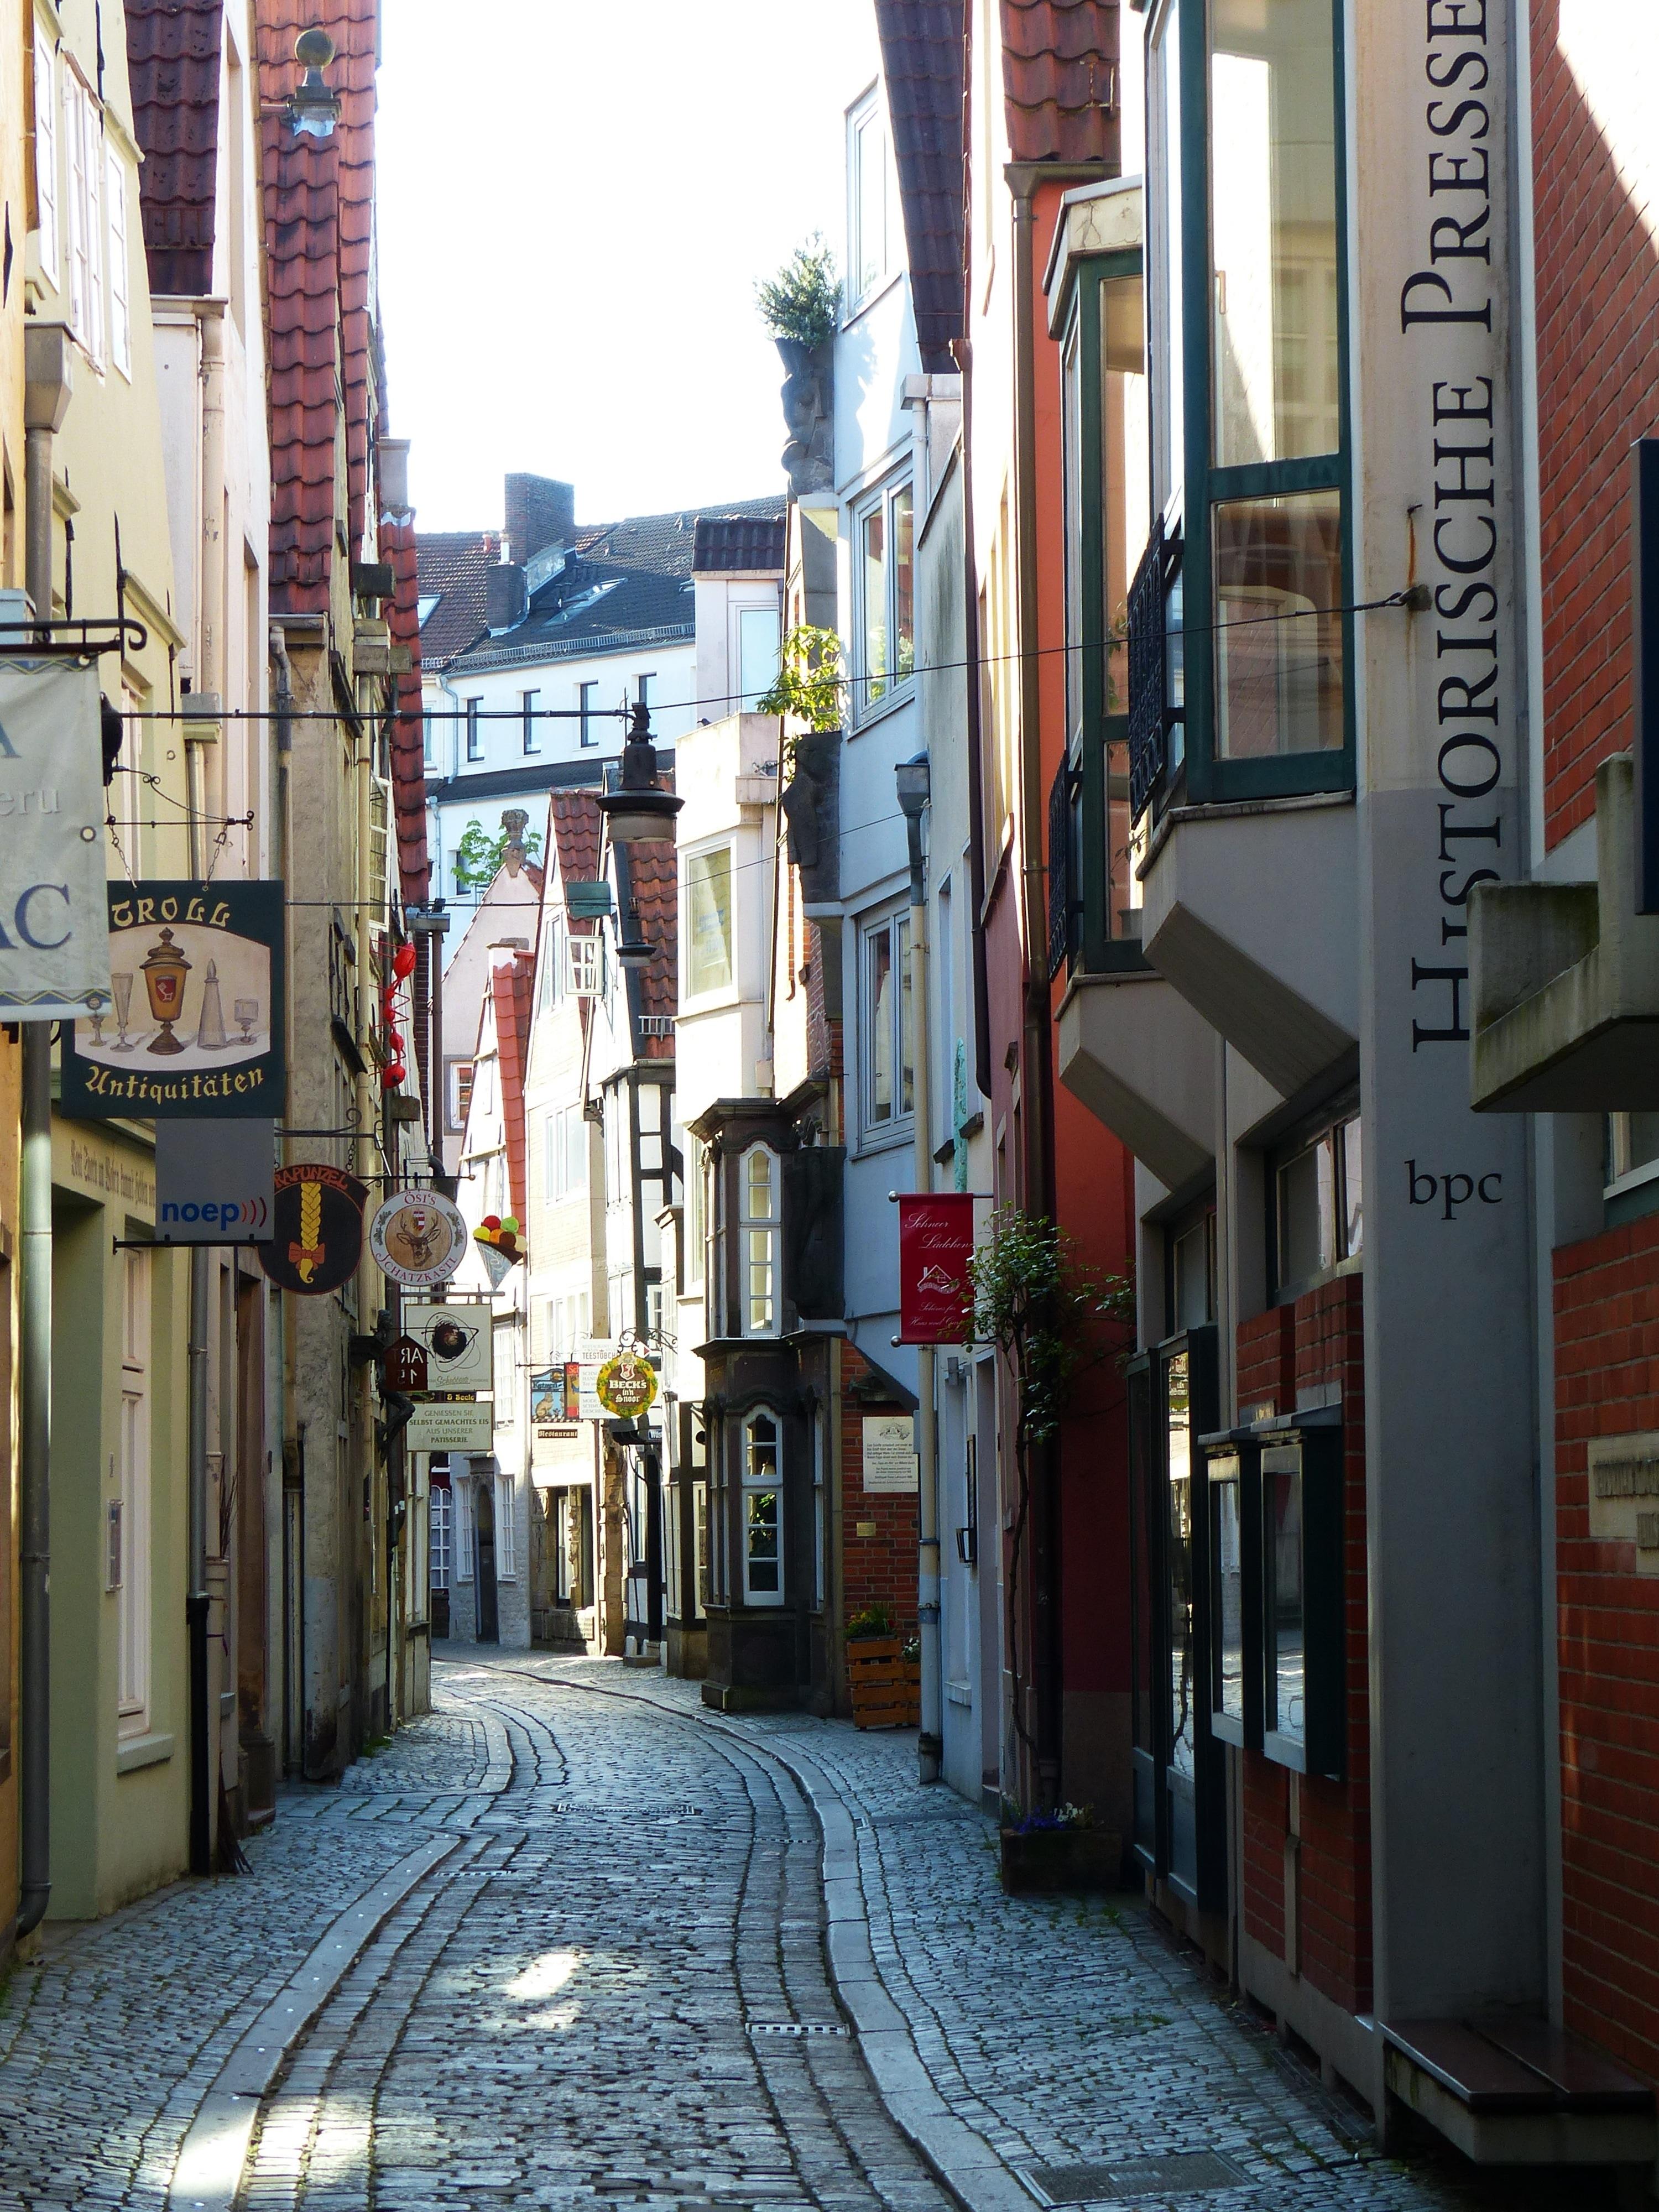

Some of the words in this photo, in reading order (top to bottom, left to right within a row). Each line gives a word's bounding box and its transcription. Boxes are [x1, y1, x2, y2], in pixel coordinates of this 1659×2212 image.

[1401, 0, 1491, 333] PRESSE
[111, 896, 231, 927] TROLL
[85, 1065, 264, 1105] Antiquitäten
[274, 1166, 348, 1189] RAPUNZEL
[1404, 1159, 1503, 1220] bpc
[161, 1202, 240, 1231] noep
[375, 1253, 458, 1282] SCHATZKASTL
